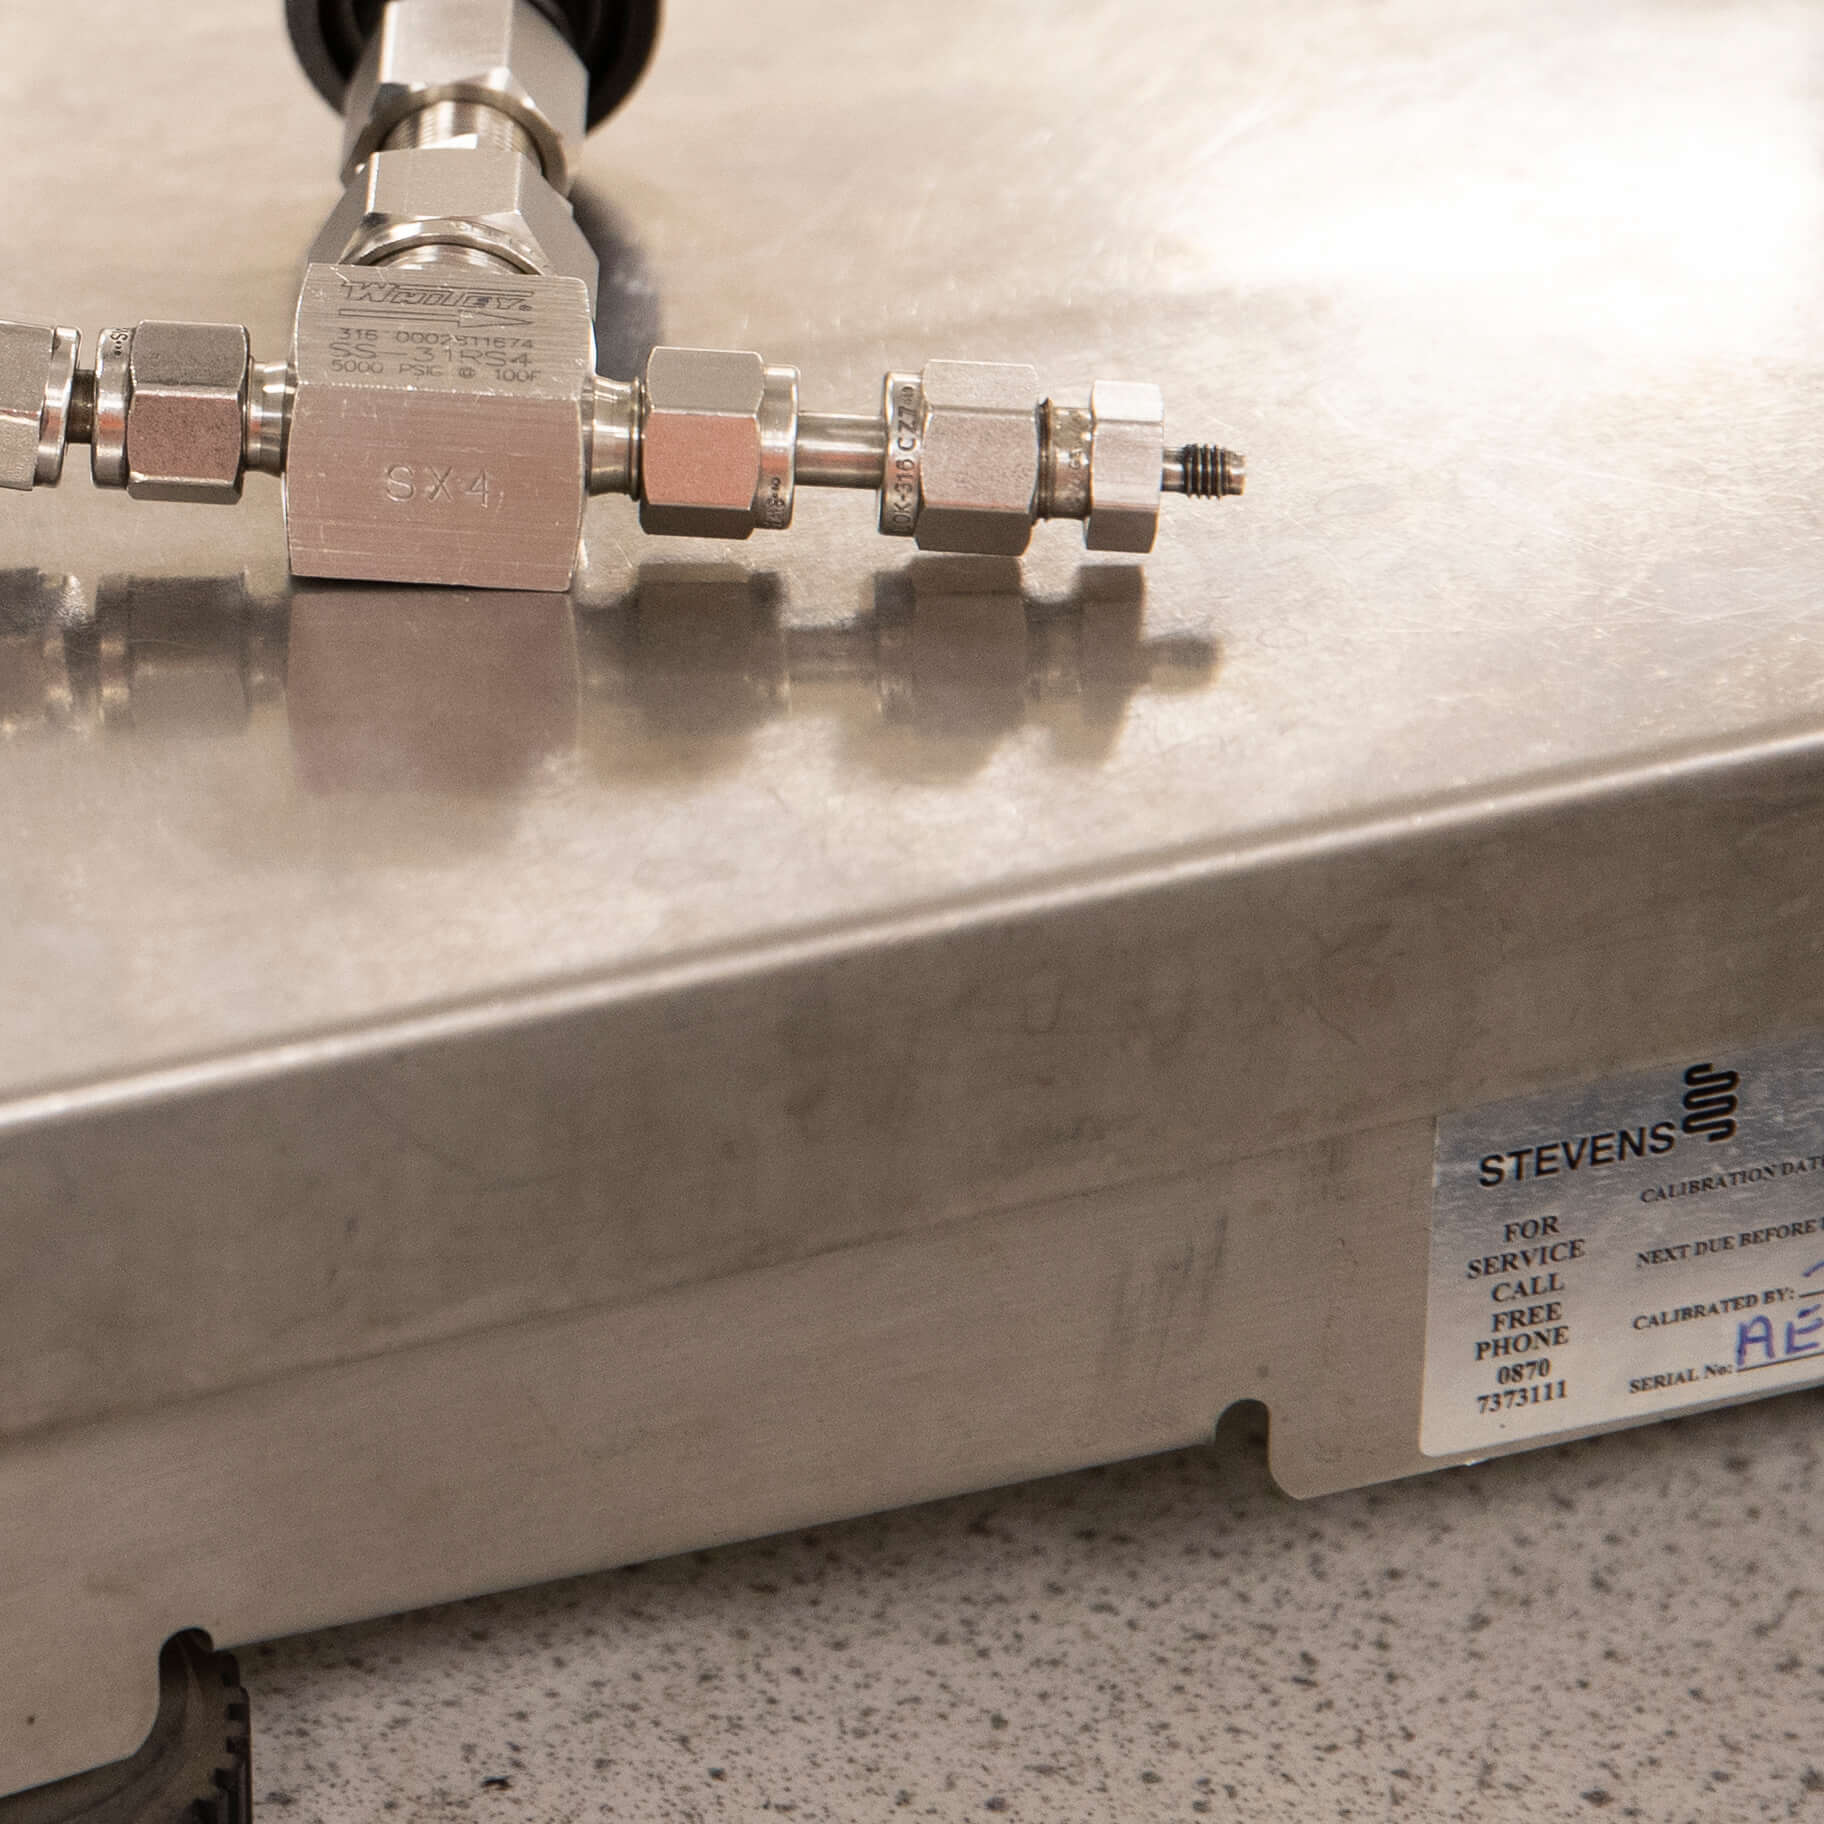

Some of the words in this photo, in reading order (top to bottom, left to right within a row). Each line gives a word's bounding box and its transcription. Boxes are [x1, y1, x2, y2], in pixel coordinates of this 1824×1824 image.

[339, 327, 379, 342] 316
[329, 358, 385, 375] 5000
[398, 362, 444, 378] PSIG
[1478, 1121, 1677, 1188] STEVENS
[1639, 1163, 1778, 1204] CALIBRATION
[1503, 1216, 1560, 1244] FOR
[1636, 1243, 1692, 1268] NEXT
[1694, 1235, 1735, 1257] DUE
[1739, 1218, 1817, 1249] BEFORE
[1467, 1238, 1586, 1280] SERVICE
[1491, 1273, 1565, 1304] CALL
[1491, 1301, 1563, 1334] FREE
[1632, 1293, 1758, 1330] CALIBRATED
[1762, 1287, 1795, 1307] BY:
[1473, 1325, 1570, 1362] PHONE
[1496, 1357, 1552, 1386] 0870
[1628, 1367, 1699, 1394] SERIAL
[1476, 1379, 1569, 1416] 7373111
